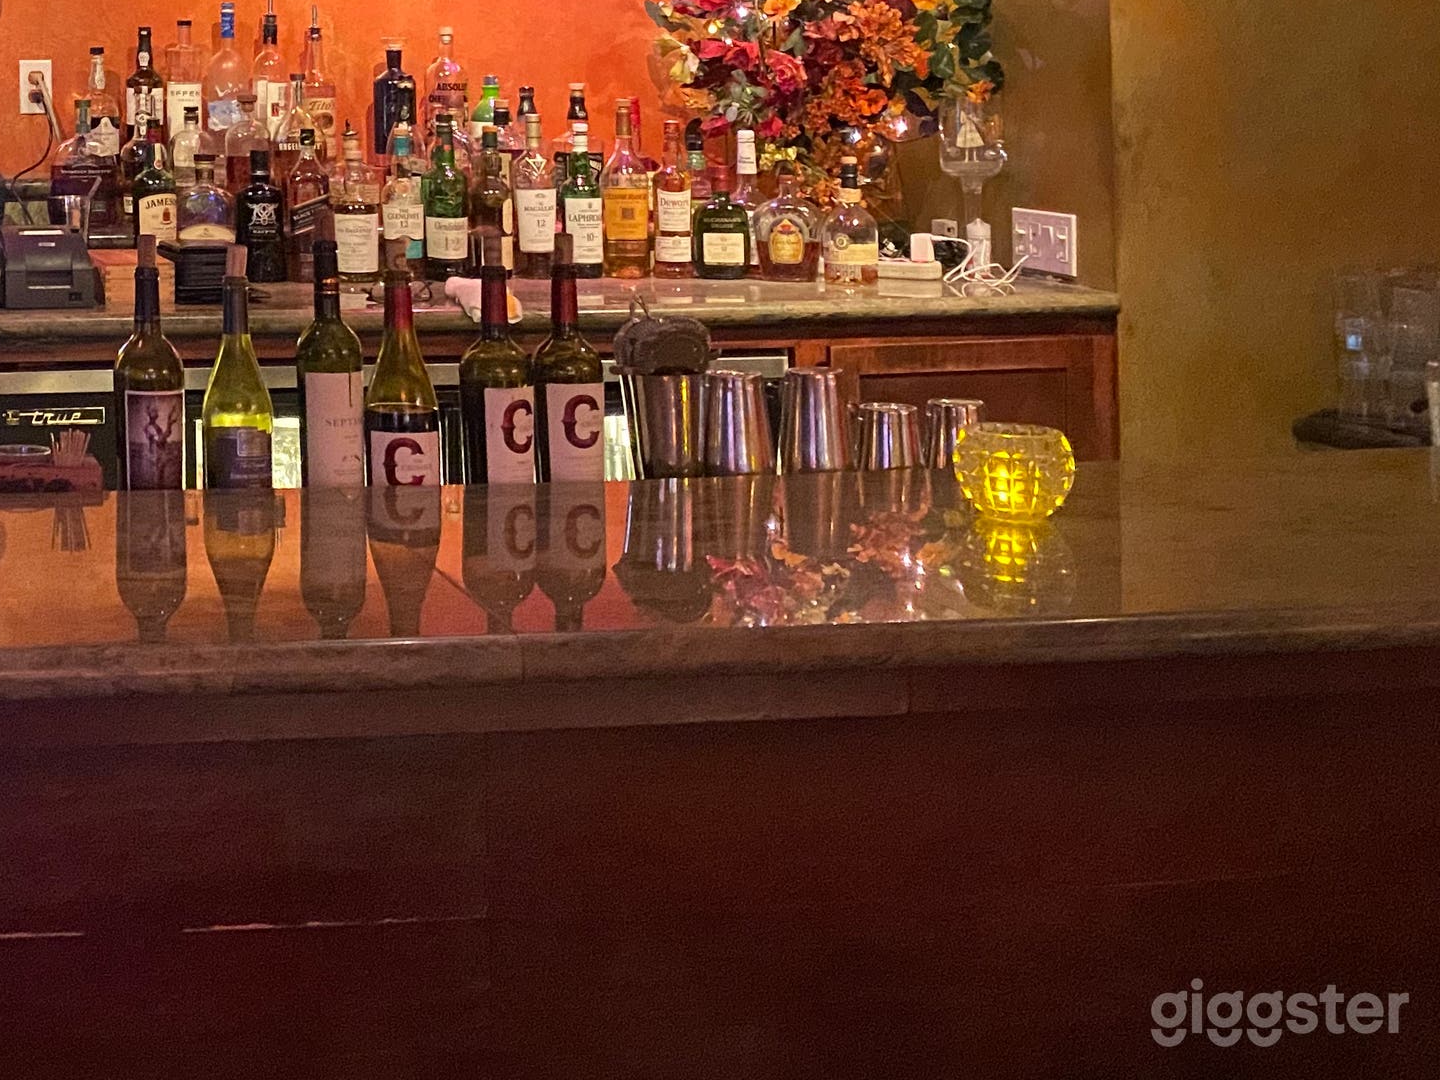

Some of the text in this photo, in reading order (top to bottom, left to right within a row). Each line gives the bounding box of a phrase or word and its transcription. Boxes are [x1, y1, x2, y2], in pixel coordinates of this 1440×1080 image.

[537, 220, 546, 228] 12
[586, 233, 594, 241] 10
[445, 235, 462, 251] 12
[501, 399, 532, 454] C
[561, 394, 600, 449] C
[383, 438, 424, 486] C
